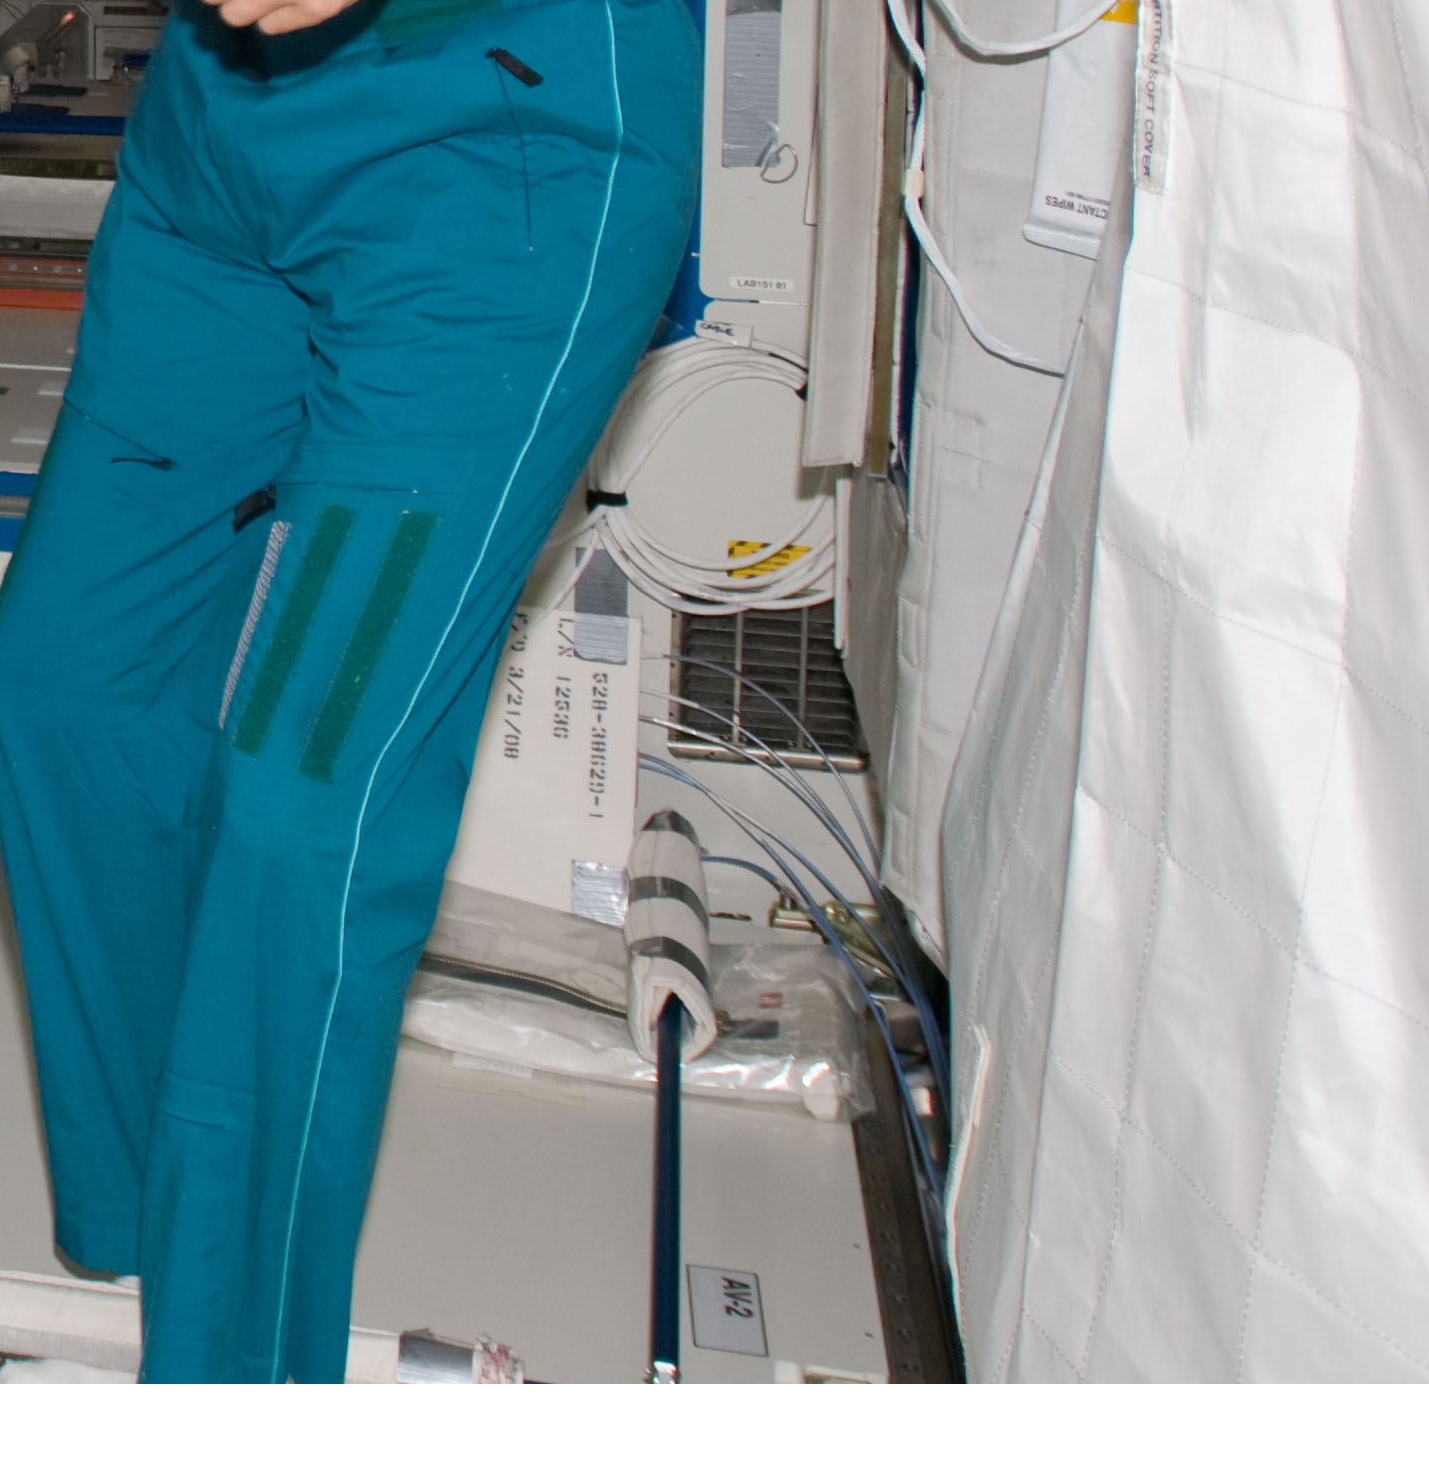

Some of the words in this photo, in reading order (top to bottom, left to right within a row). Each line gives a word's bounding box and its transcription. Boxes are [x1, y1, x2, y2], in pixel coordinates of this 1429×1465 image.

[1144, 70, 1156, 113] SOFT
[1142, 118, 1155, 177] COVER
[1045, 195, 1075, 213] WIPES
[720, 1276, 754, 1318] AV-2
